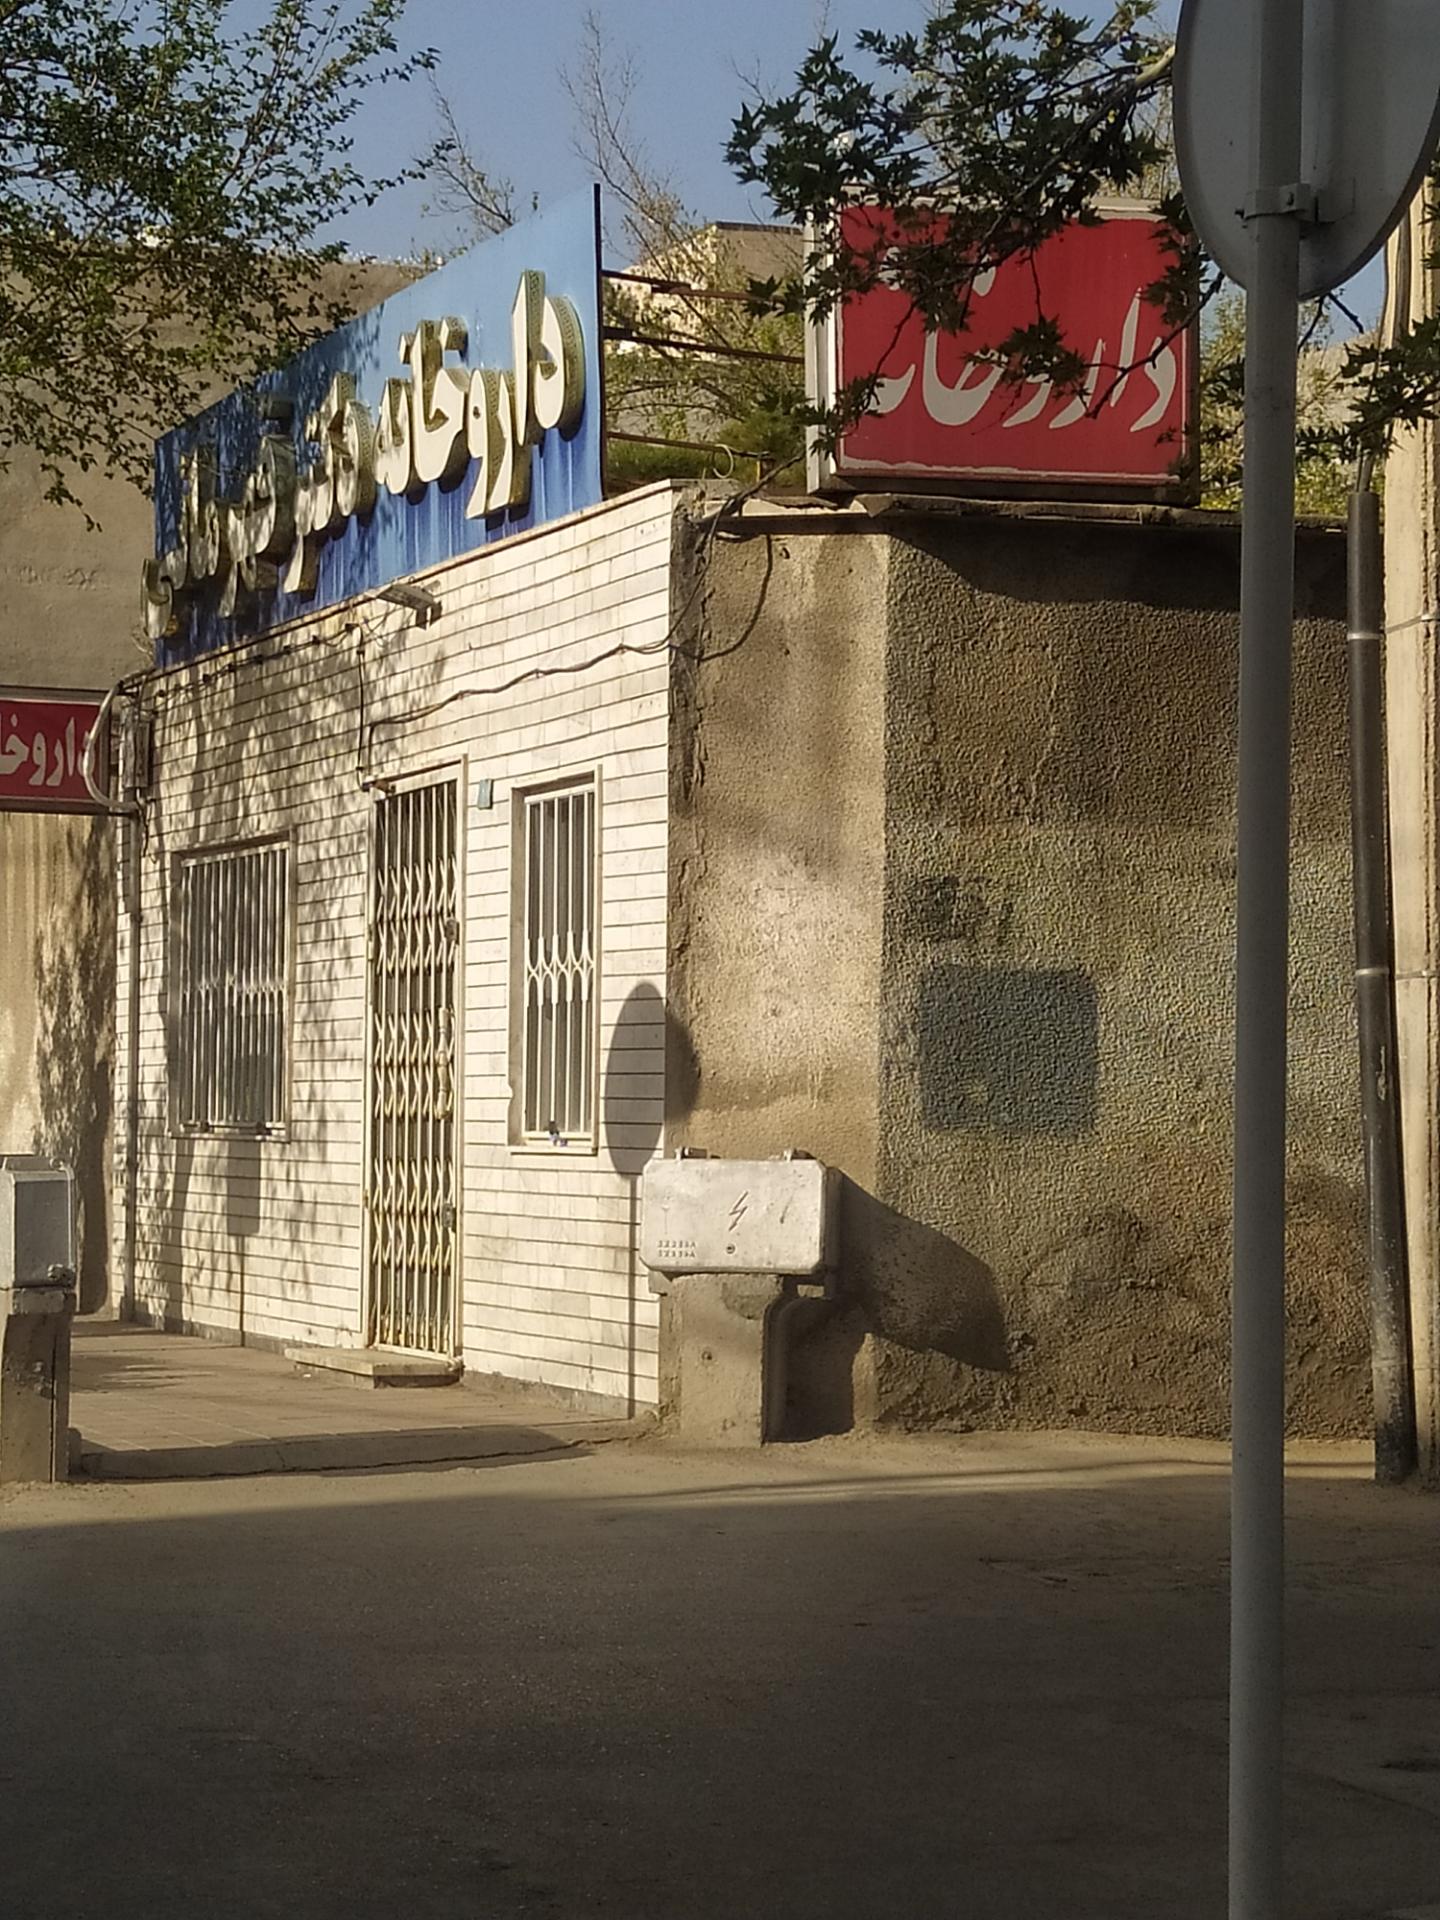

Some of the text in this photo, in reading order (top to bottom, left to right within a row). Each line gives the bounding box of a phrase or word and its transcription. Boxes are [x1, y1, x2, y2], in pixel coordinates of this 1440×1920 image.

[374, 269, 585, 519] داروخانه
[862, 246, 1177, 432] داروخان
[284, 372, 375, 594] دکتر
